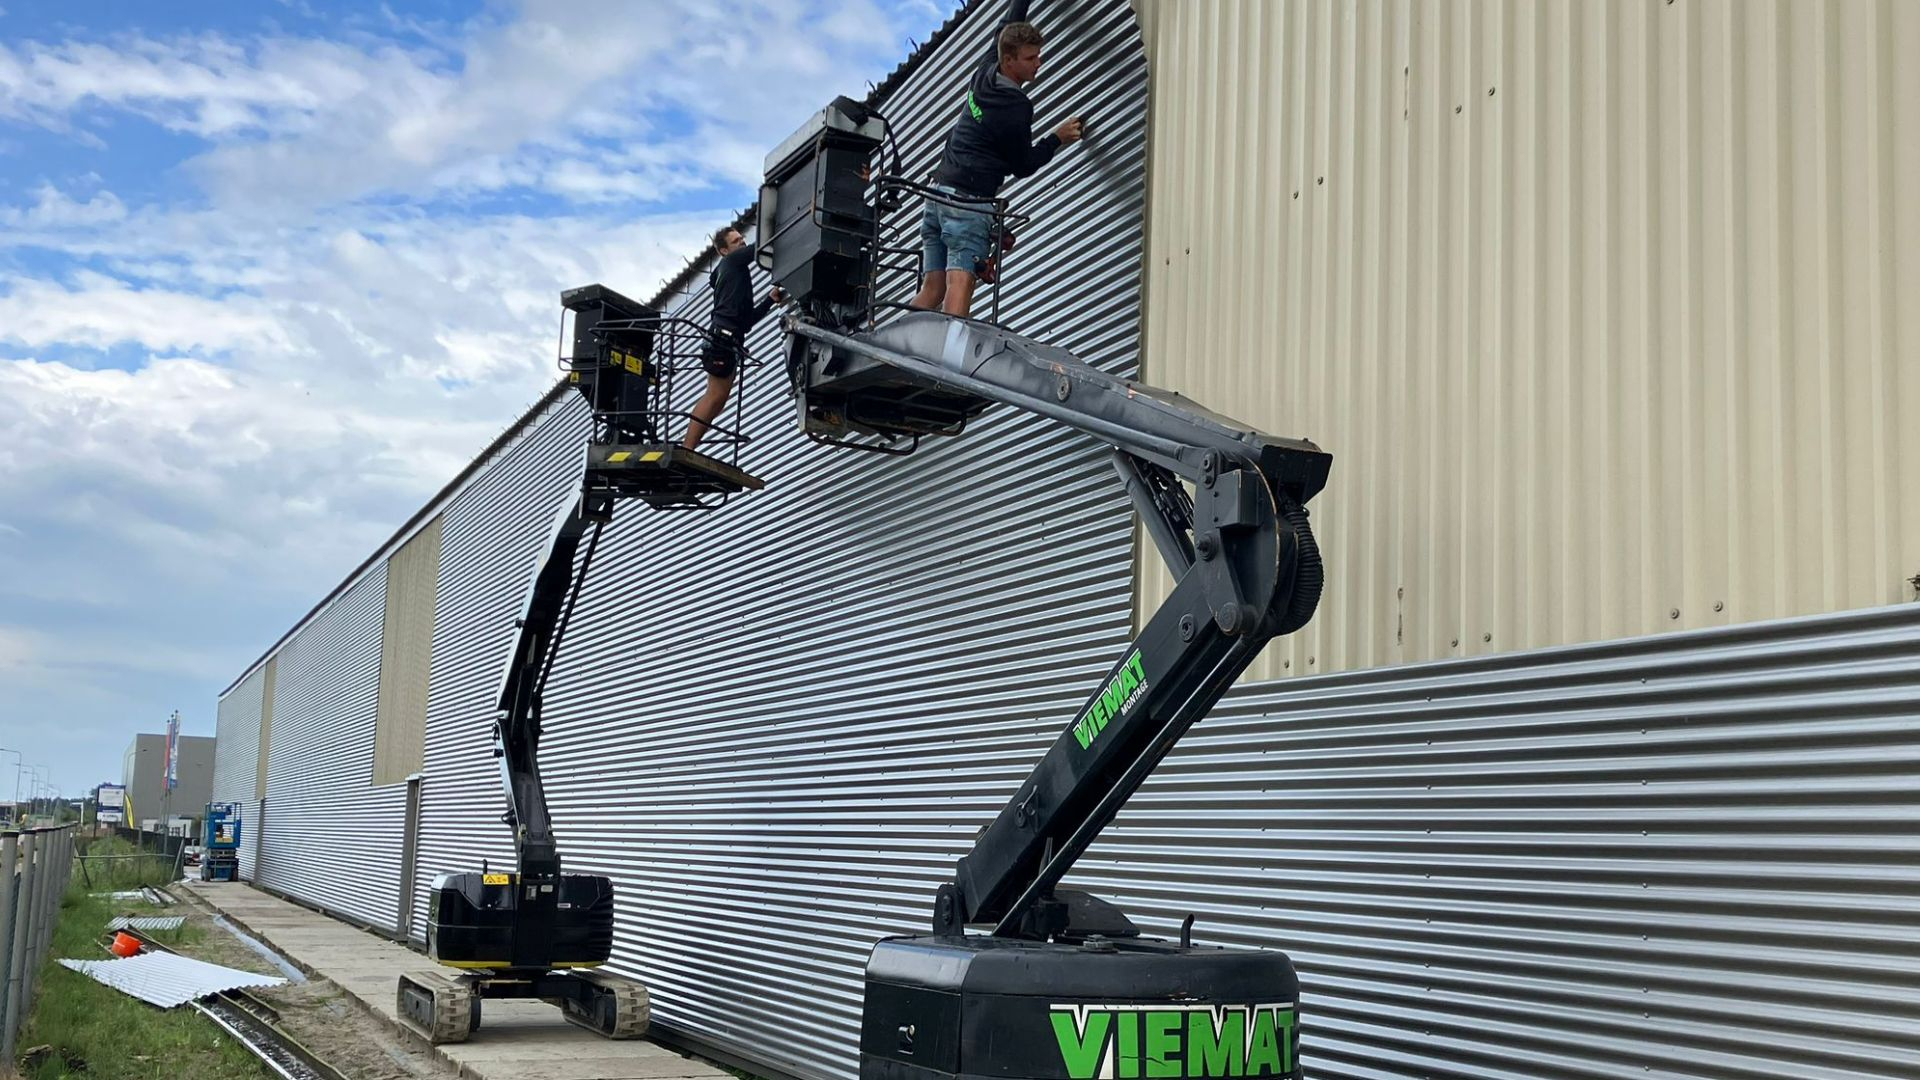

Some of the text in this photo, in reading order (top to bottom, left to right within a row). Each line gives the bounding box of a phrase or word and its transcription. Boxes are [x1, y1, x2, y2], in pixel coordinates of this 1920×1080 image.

[1073, 648, 1145, 750] VIEMAT
[1120, 679, 1149, 716] MONTAGE
[1049, 1003, 1294, 1079] VIEMAT
